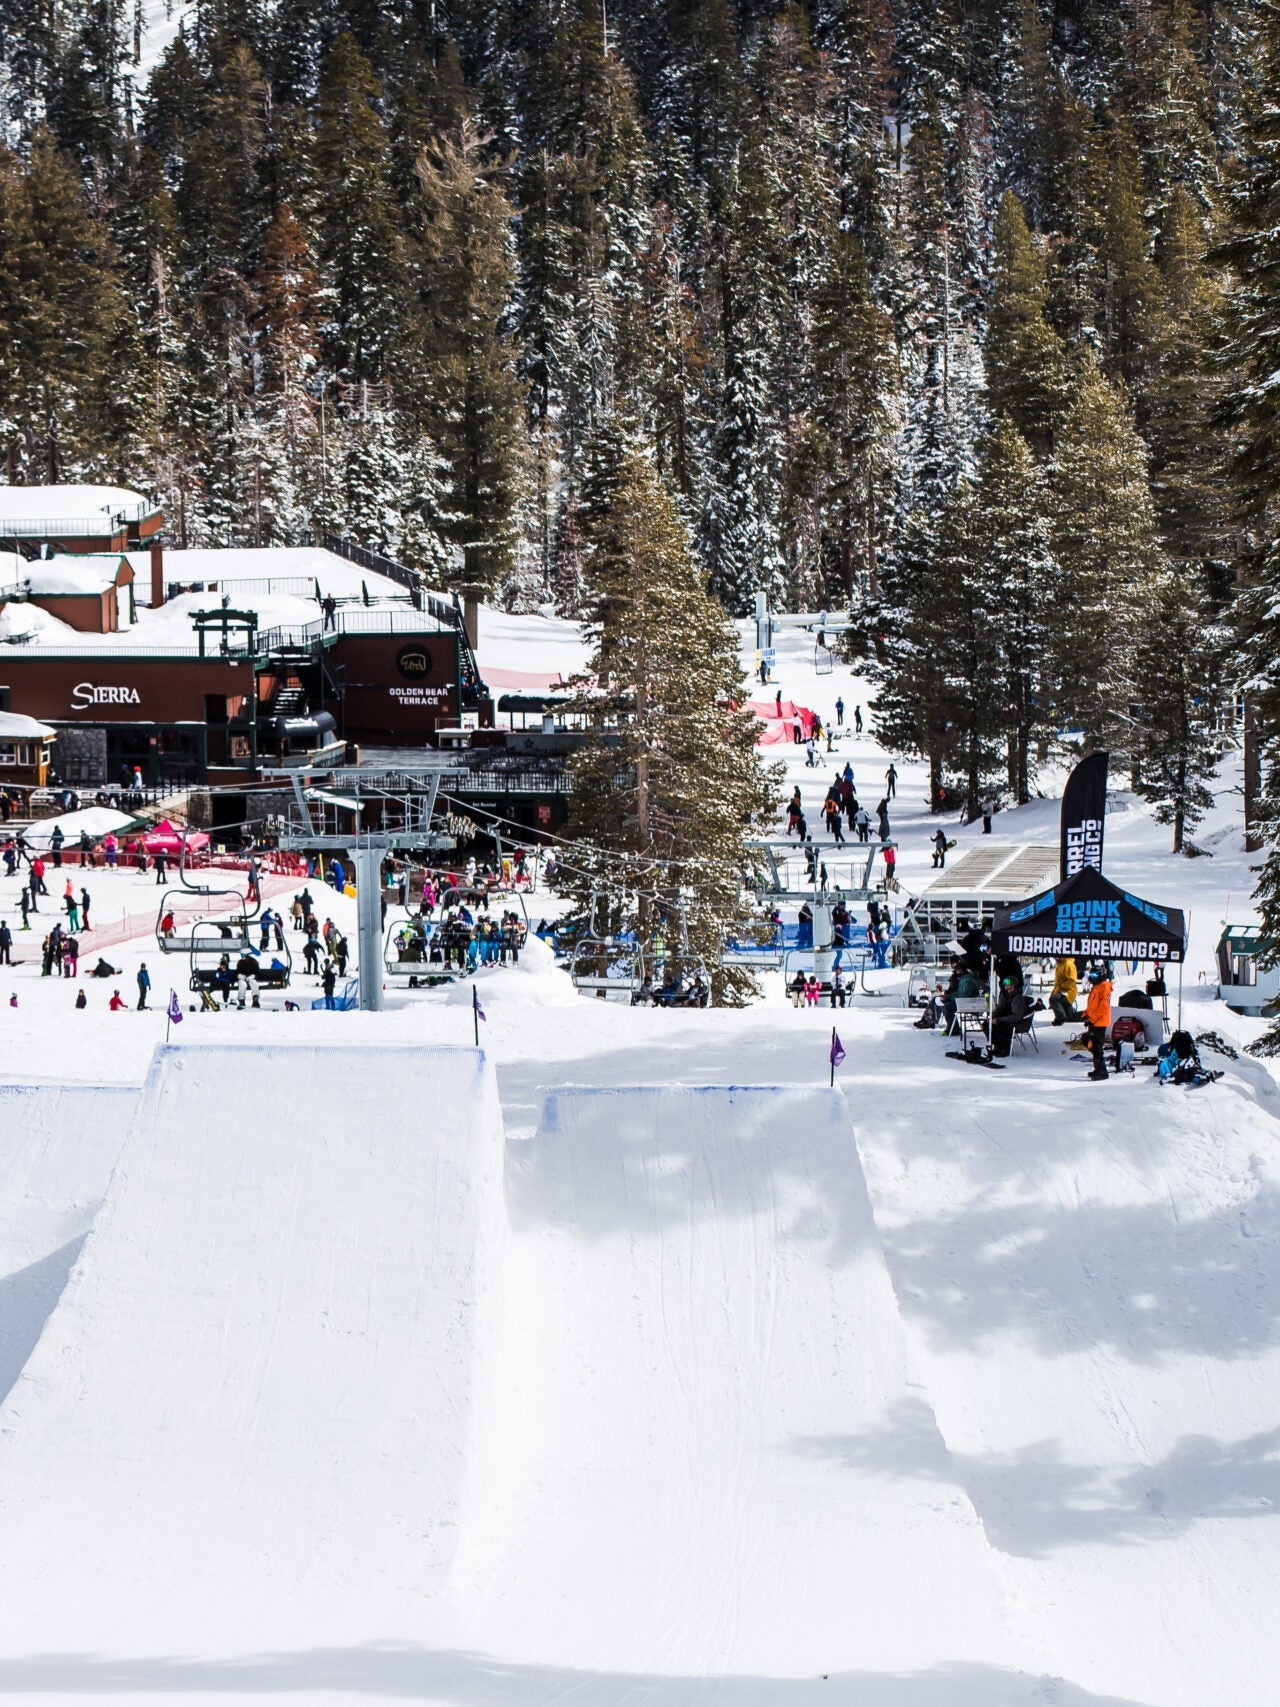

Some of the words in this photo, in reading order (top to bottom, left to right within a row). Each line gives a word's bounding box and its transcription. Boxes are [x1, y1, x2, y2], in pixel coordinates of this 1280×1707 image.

[70, 682, 141, 709] SIERRA
[389, 688, 424, 696] GOLDEN
[425, 688, 449, 696] BEAR
[398, 697, 439, 705] TERRACE
[1067, 819, 1086, 879] RREL
[1056, 900, 1122, 919] DRINK
[1056, 917, 1121, 933] BEER
